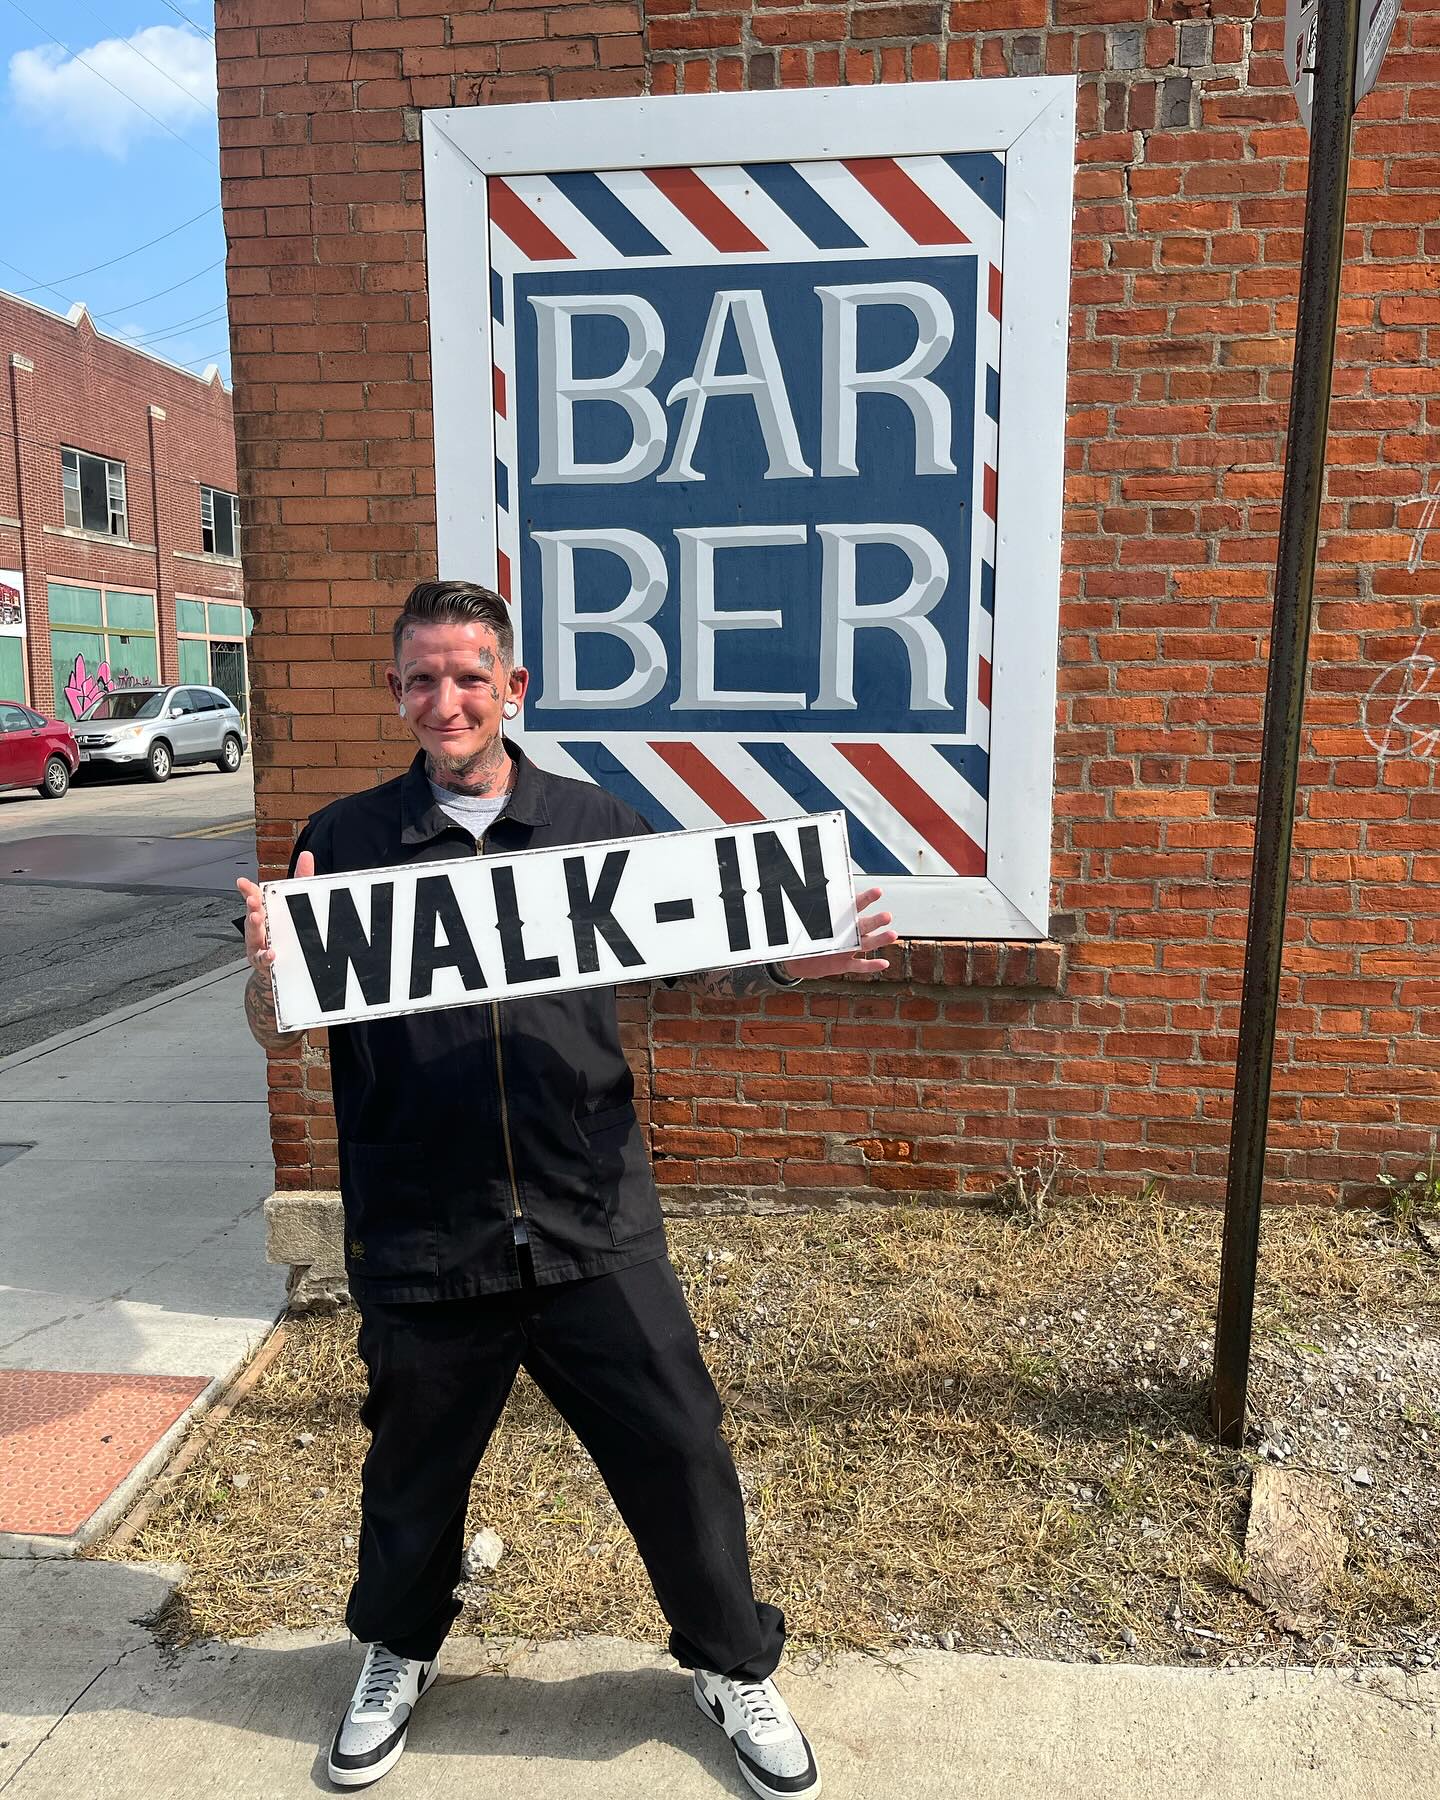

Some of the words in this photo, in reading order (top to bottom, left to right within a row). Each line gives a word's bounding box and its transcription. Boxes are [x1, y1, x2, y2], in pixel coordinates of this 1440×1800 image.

[527, 281, 957, 485] BAR
[530, 523, 954, 711] BER
[286, 825, 834, 1012] WALK-IN
